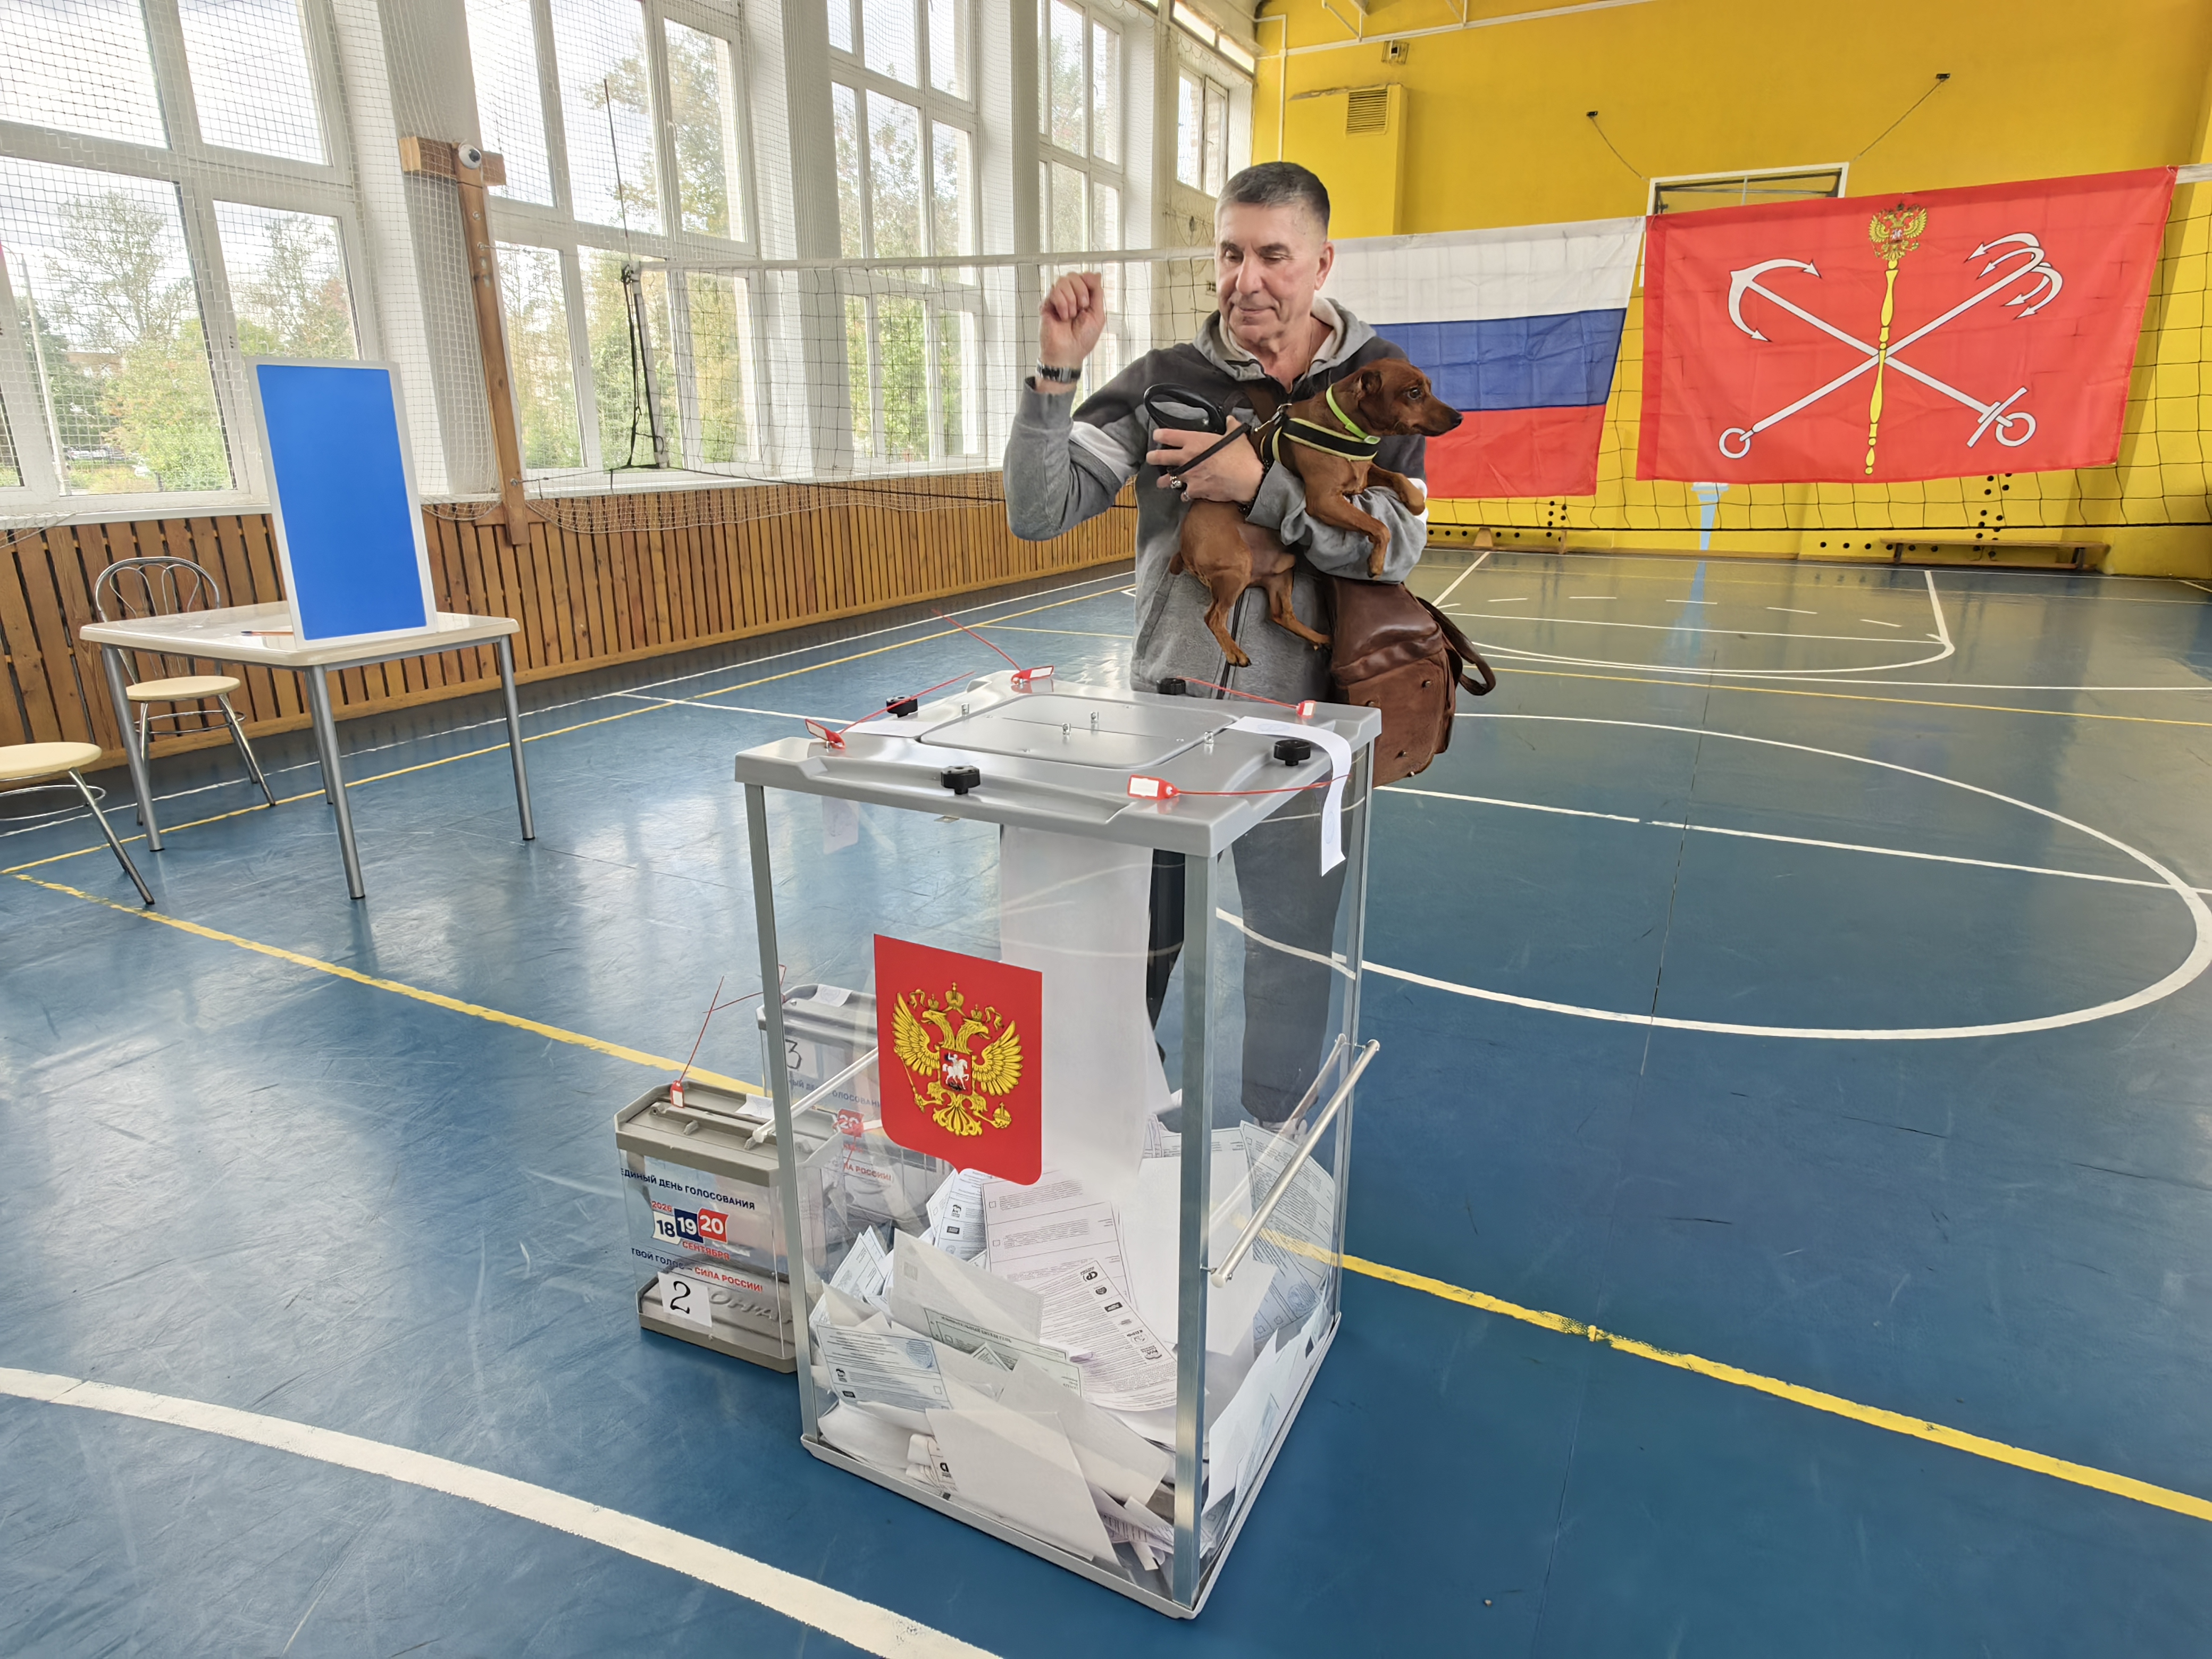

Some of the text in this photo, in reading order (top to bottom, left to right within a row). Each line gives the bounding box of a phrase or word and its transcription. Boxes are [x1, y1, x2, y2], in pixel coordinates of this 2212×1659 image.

[785, 1038, 802, 1069] 3
[827, 1091, 880, 1108] ОЛОСОВАН
[621, 1168, 755, 1210] ЕДИНЫЙ ДЕНЬ ГОЛОСОВАНИЯ
[651, 1201, 672, 1212] 2026
[656, 1215, 724, 1237] 18 19 20
[682, 1241, 730, 1260] СЕНТЯБРЯ
[631, 1247, 653, 1261] ТВОЙ
[656, 1255, 684, 1269] ГОЛОС
[694, 1266, 719, 1280] СИЛА
[722, 1275, 763, 1293] РОССИИ!
[670, 1281, 691, 1314] 2
